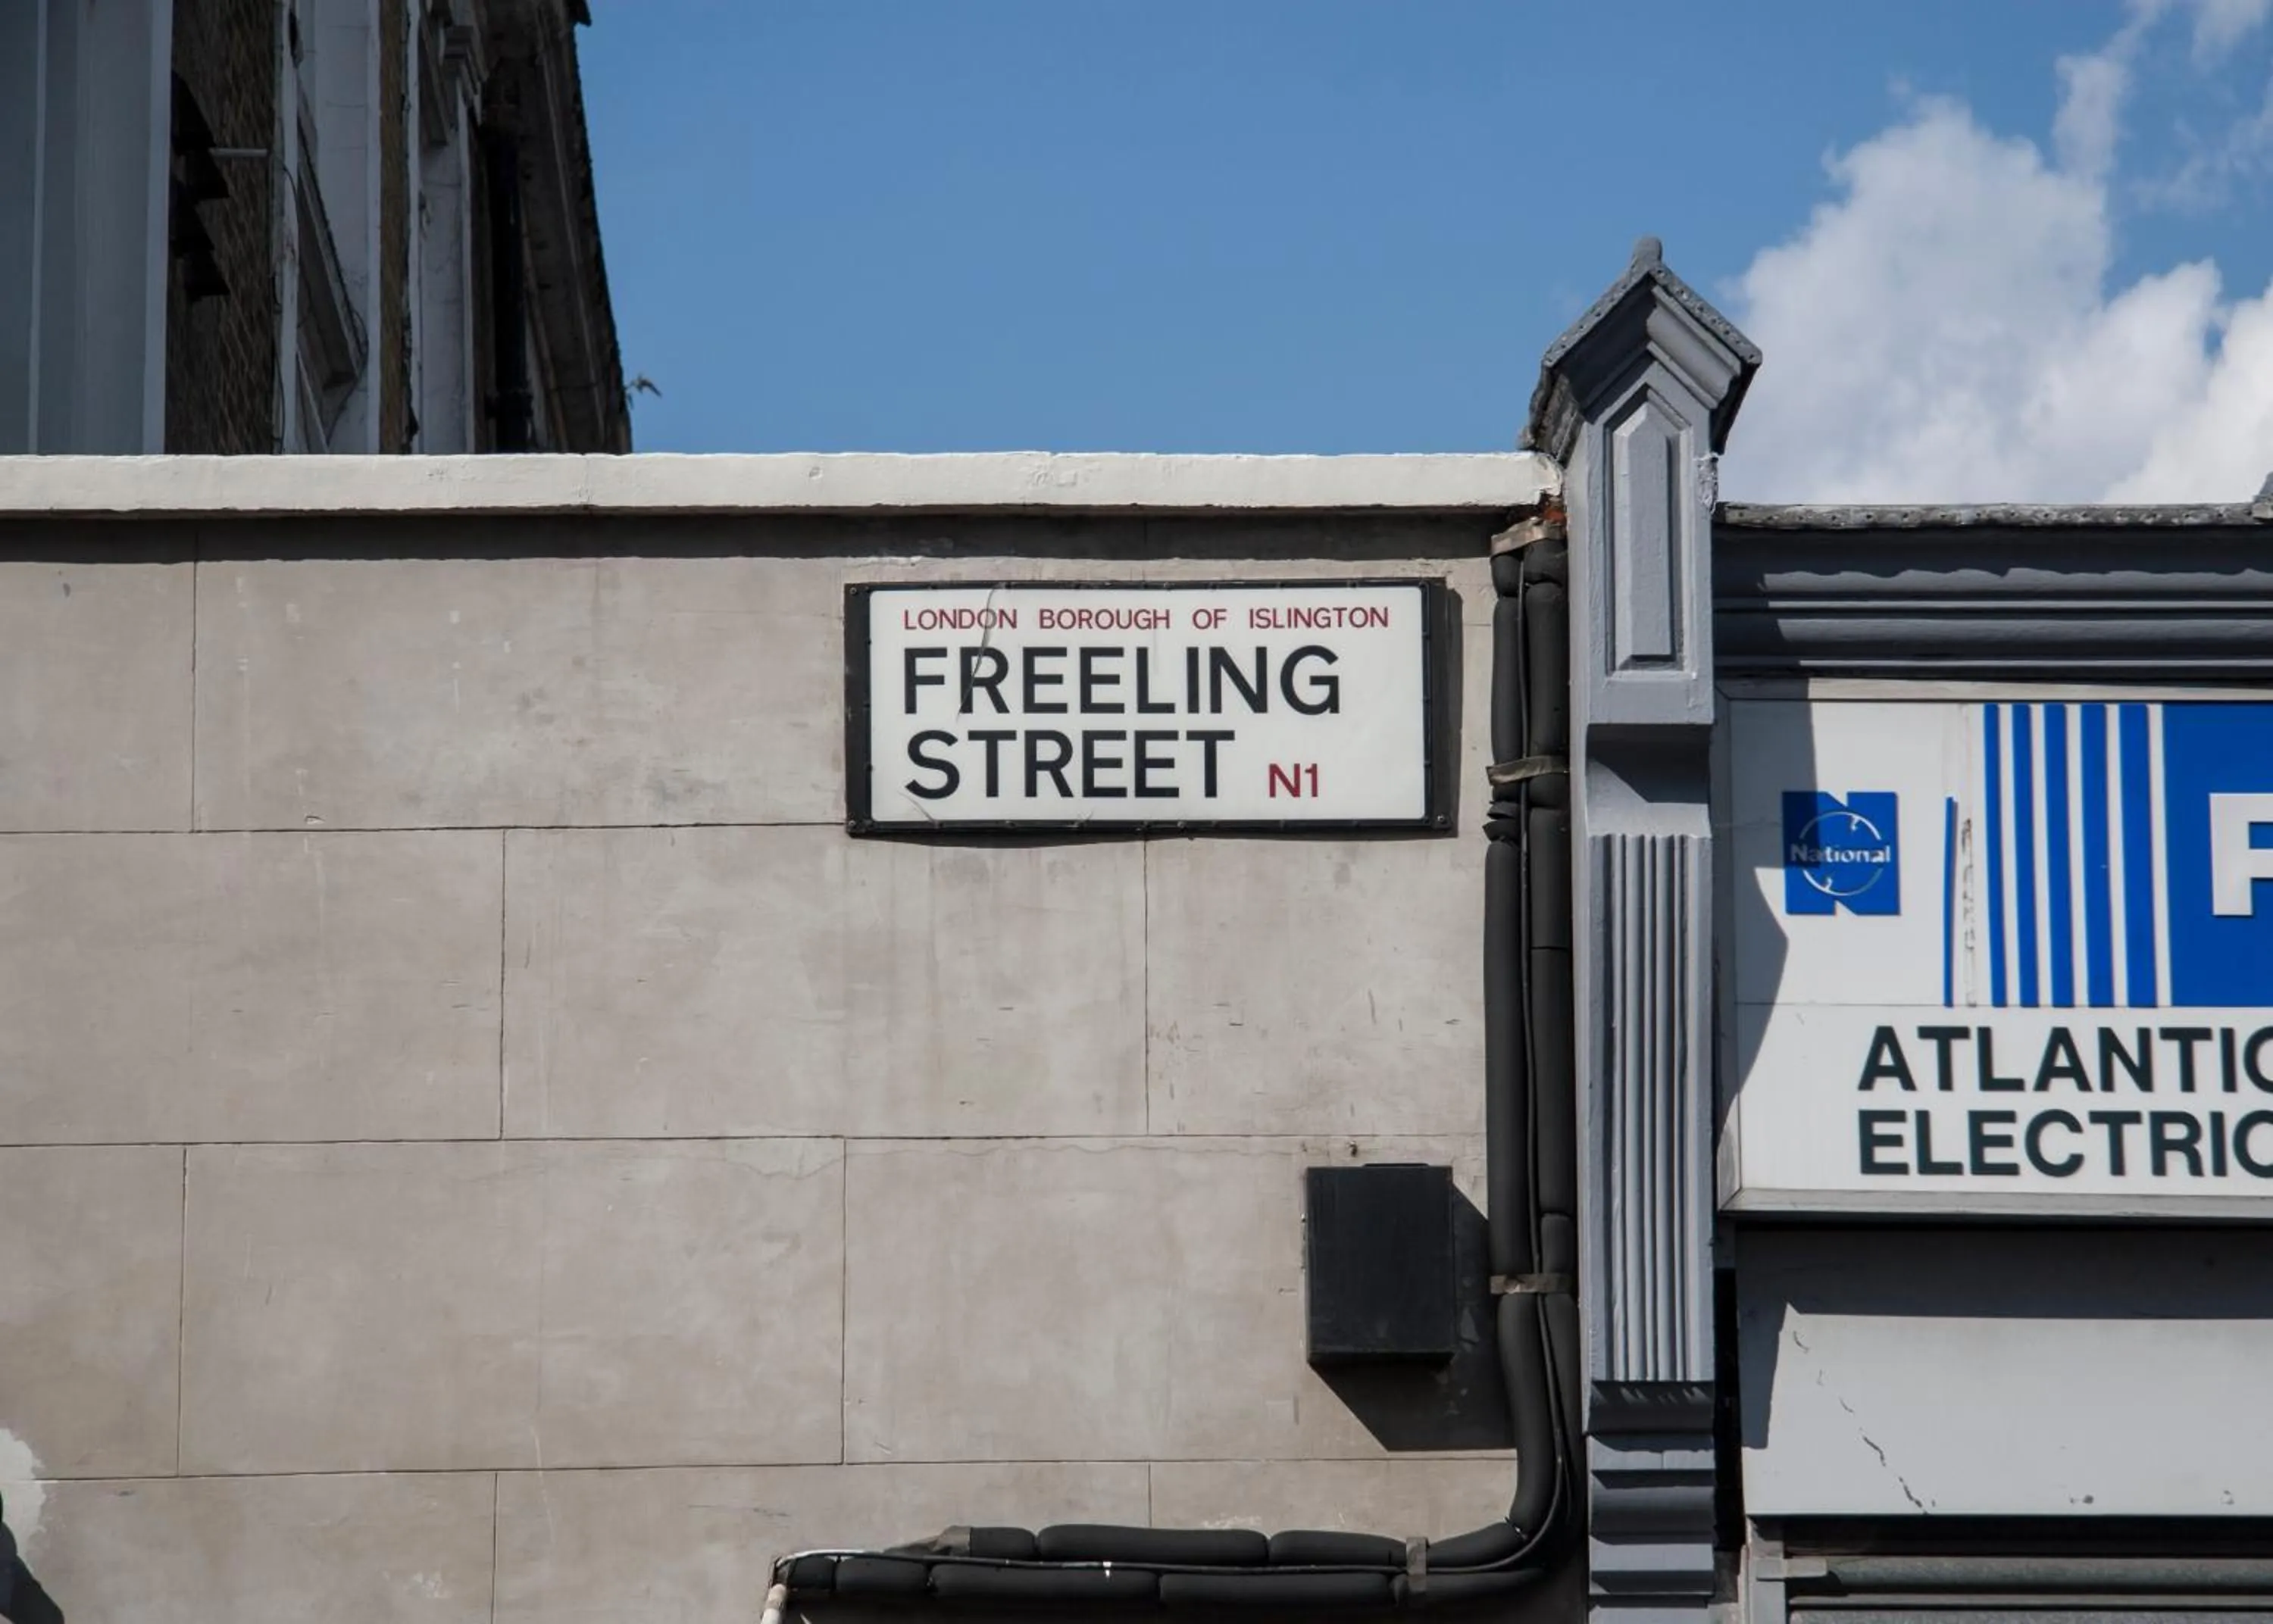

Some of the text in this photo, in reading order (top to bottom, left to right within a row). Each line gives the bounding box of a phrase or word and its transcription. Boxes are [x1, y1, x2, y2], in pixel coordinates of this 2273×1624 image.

[904, 607, 1389, 629] LONDON BOROUGH OF ISLINGTON
[904, 645, 1340, 715] FREELING
[905, 729, 1319, 799] STREET N1
[1790, 844, 1890, 863] National
[1858, 1109, 2273, 1179] ELECTRIC
